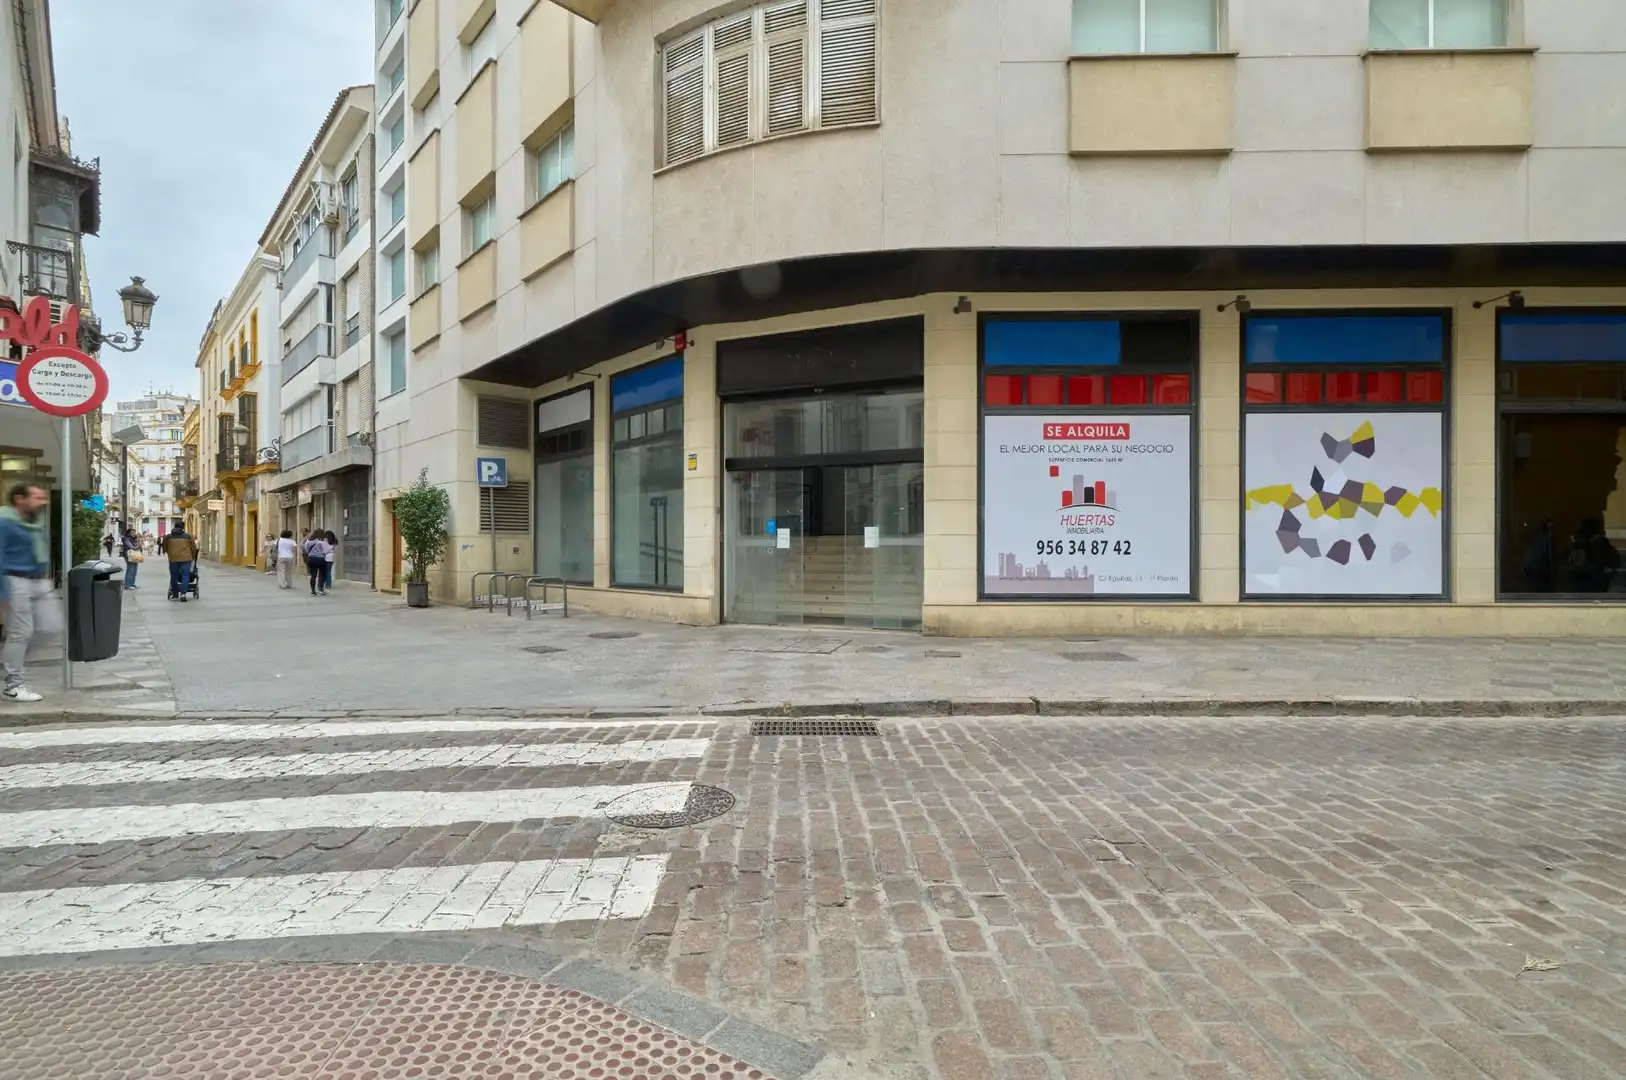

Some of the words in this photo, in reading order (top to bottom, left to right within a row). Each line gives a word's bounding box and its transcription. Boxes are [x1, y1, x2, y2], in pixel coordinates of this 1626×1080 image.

[48, 361, 77, 369] Excepto
[32, 369, 53, 377] Carga
[60, 371, 93, 380] Descarga
[1047, 426, 1062, 437] SE
[1067, 426, 1126, 437] ALQUILA
[1000, 445, 1010, 453] EL
[1012, 445, 1045, 453] MEJOR
[1047, 445, 1081, 453] LOCAL
[1083, 445, 1109, 453] PARA
[1111, 445, 1123, 453] SU
[1125, 445, 1174, 453] NEGOCIO
[481, 461, 499, 482] P
[1060, 515, 1116, 526] HUERTAS
[1036, 540, 1063, 555] 956
[1068, 540, 1086, 555] 34
[1091, 540, 1108, 555] 87
[1113, 540, 1131, 555] 42
